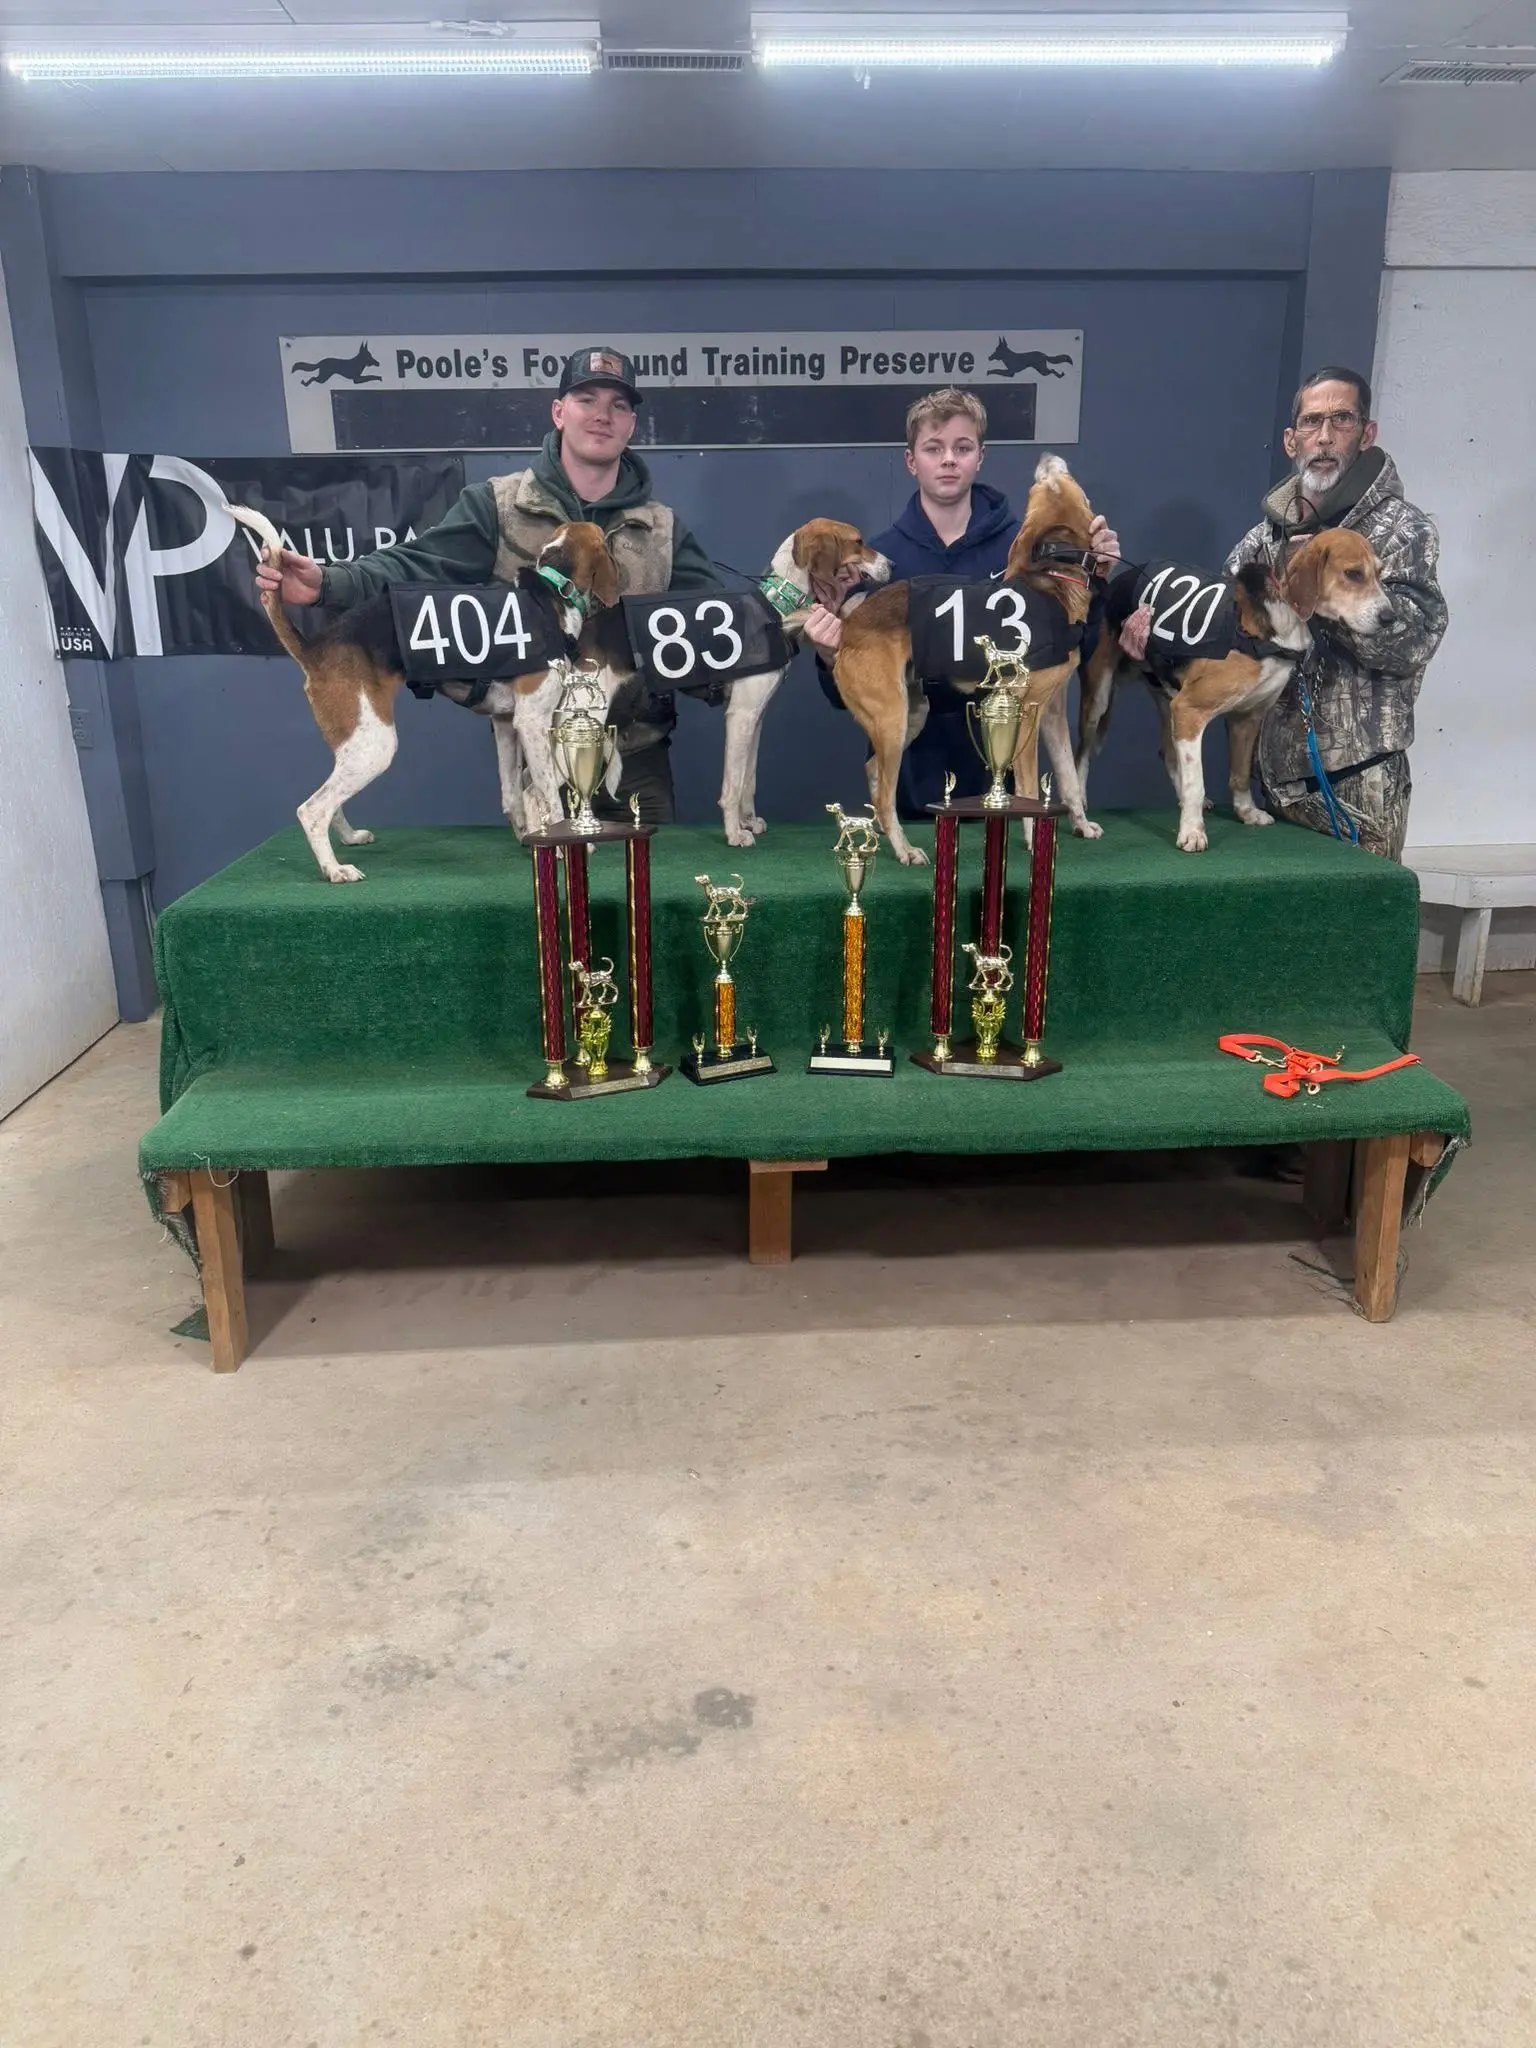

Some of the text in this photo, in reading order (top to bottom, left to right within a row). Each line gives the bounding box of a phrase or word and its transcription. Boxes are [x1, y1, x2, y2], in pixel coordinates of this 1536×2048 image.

[396, 348, 508, 378] Poole's
[702, 346, 825, 381] Training
[840, 345, 975, 374] Preserve
[409, 591, 532, 665] 404
[647, 600, 744, 679] 83
[935, 587, 1031, 661] 13
[1139, 566, 1226, 645] 420
[61, 637, 93, 652] USA
